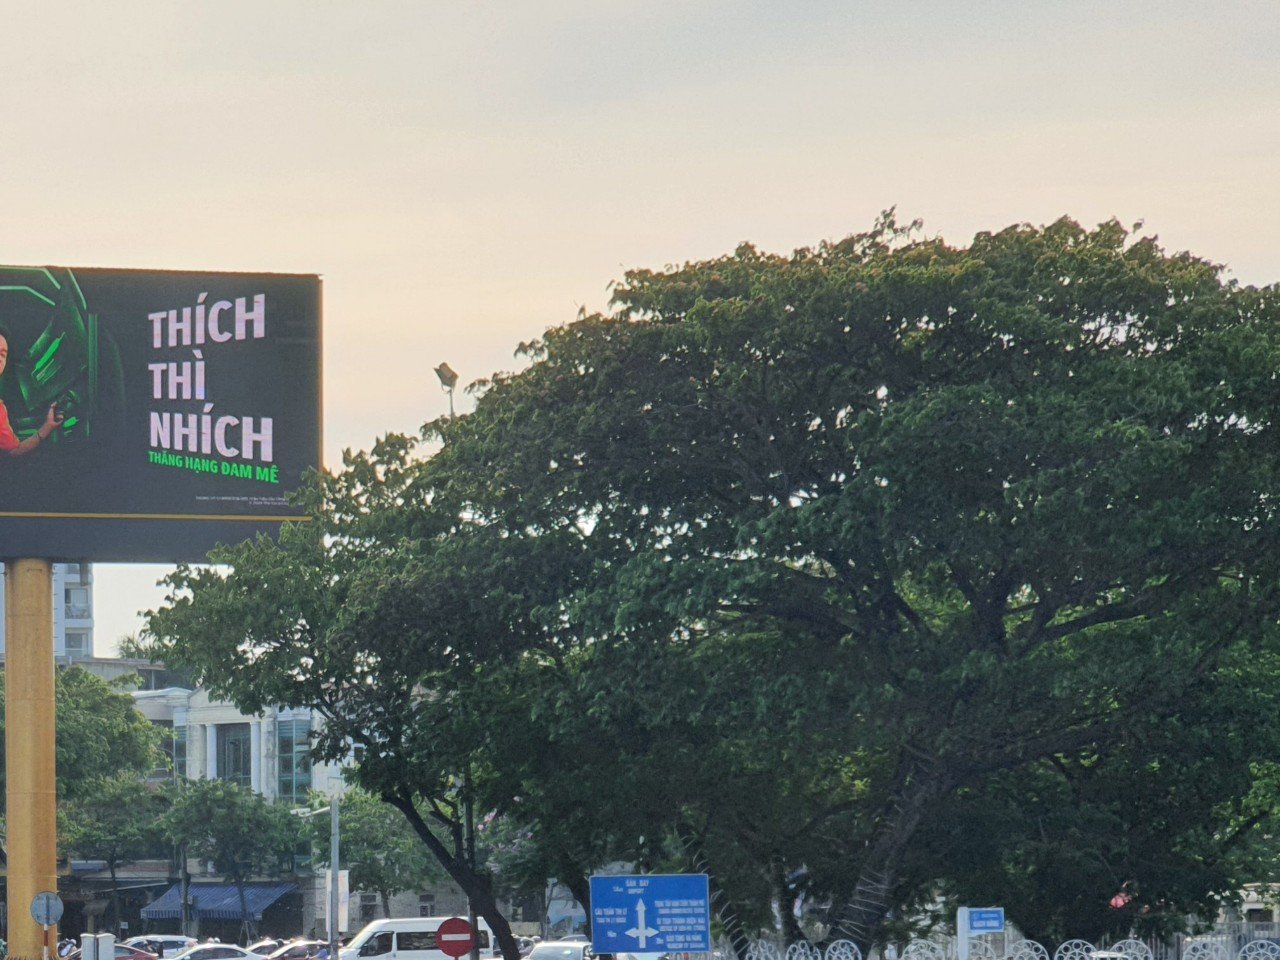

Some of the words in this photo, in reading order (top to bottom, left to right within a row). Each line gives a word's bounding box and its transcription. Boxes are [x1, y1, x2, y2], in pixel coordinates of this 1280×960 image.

[148, 292, 265, 348] THÍCH
[148, 350, 205, 399] THÌ
[150, 403, 273, 462] NHÍCH
[185, 456, 218, 474] HẠNG
[221, 462, 252, 479] ĐAM
[256, 465, 279, 484] MÊ
